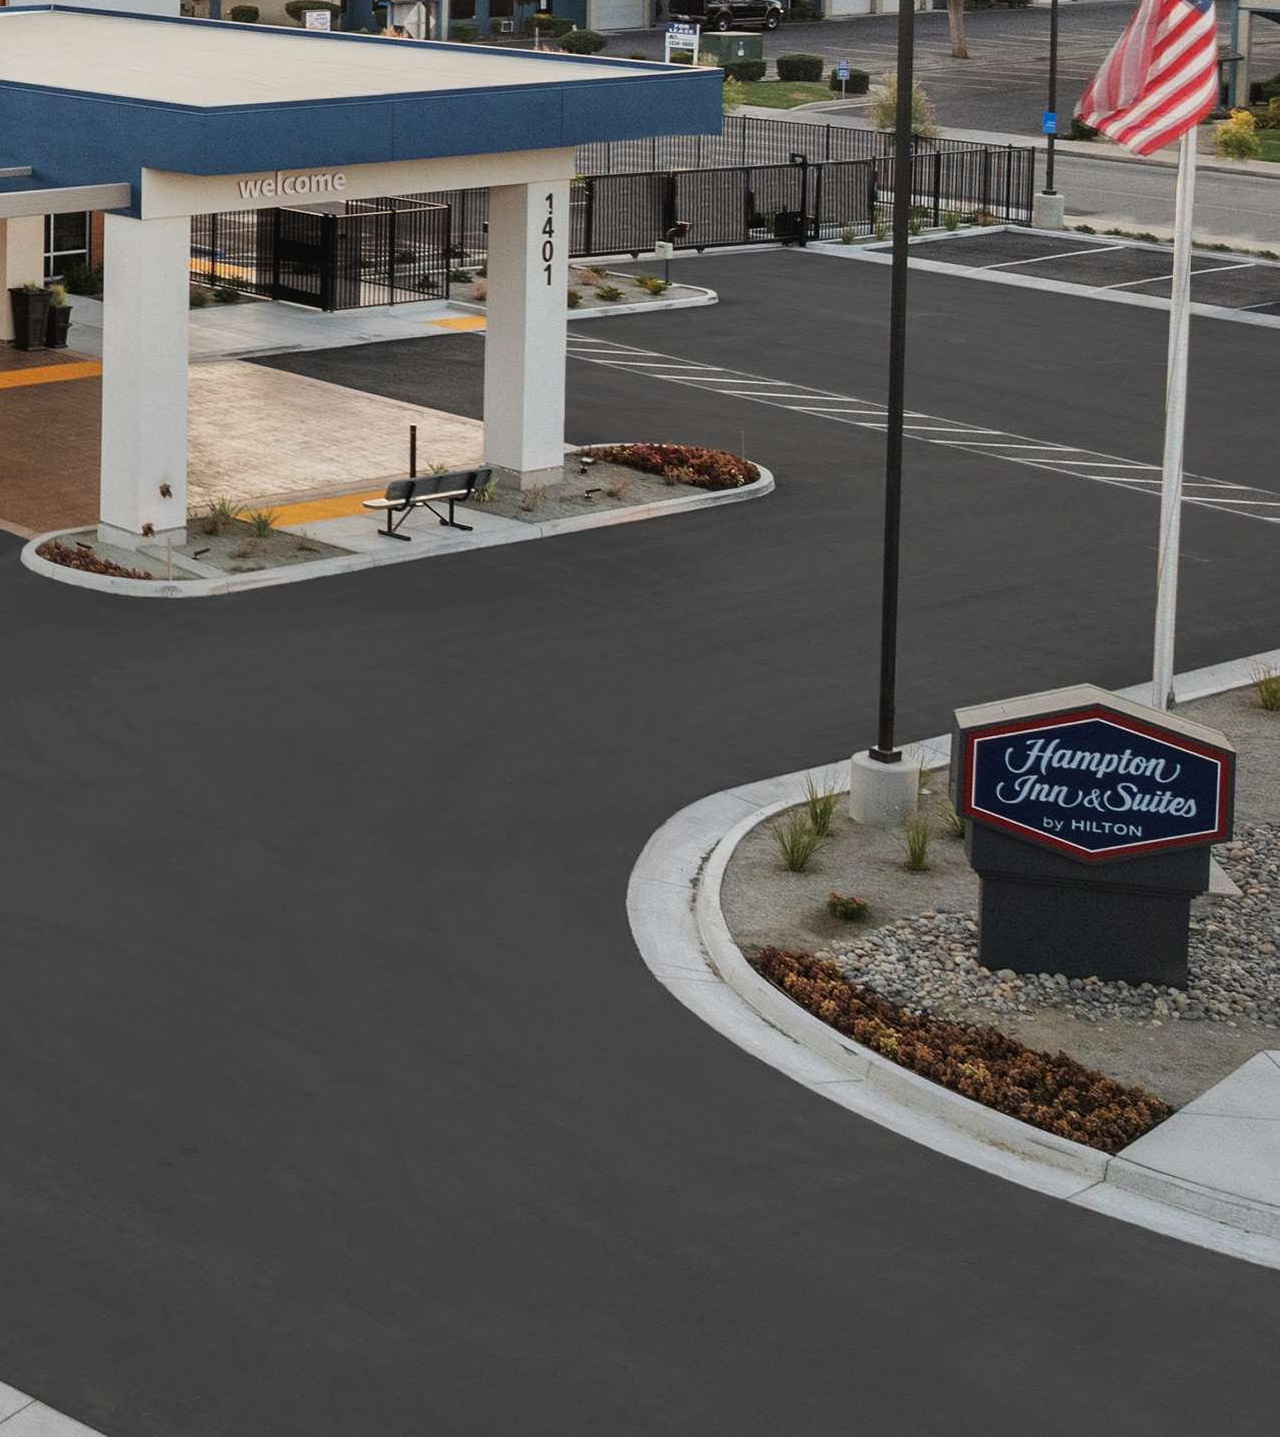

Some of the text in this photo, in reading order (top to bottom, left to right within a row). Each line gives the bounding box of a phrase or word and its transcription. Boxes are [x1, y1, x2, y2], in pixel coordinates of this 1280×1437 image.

[238, 170, 346, 200] welcome
[542, 192, 555, 286] 1401
[1005, 738, 1181, 783] Hampton
[996, 774, 1197, 818] Inn & Suites
[1043, 816, 1142, 837] by HILTON
